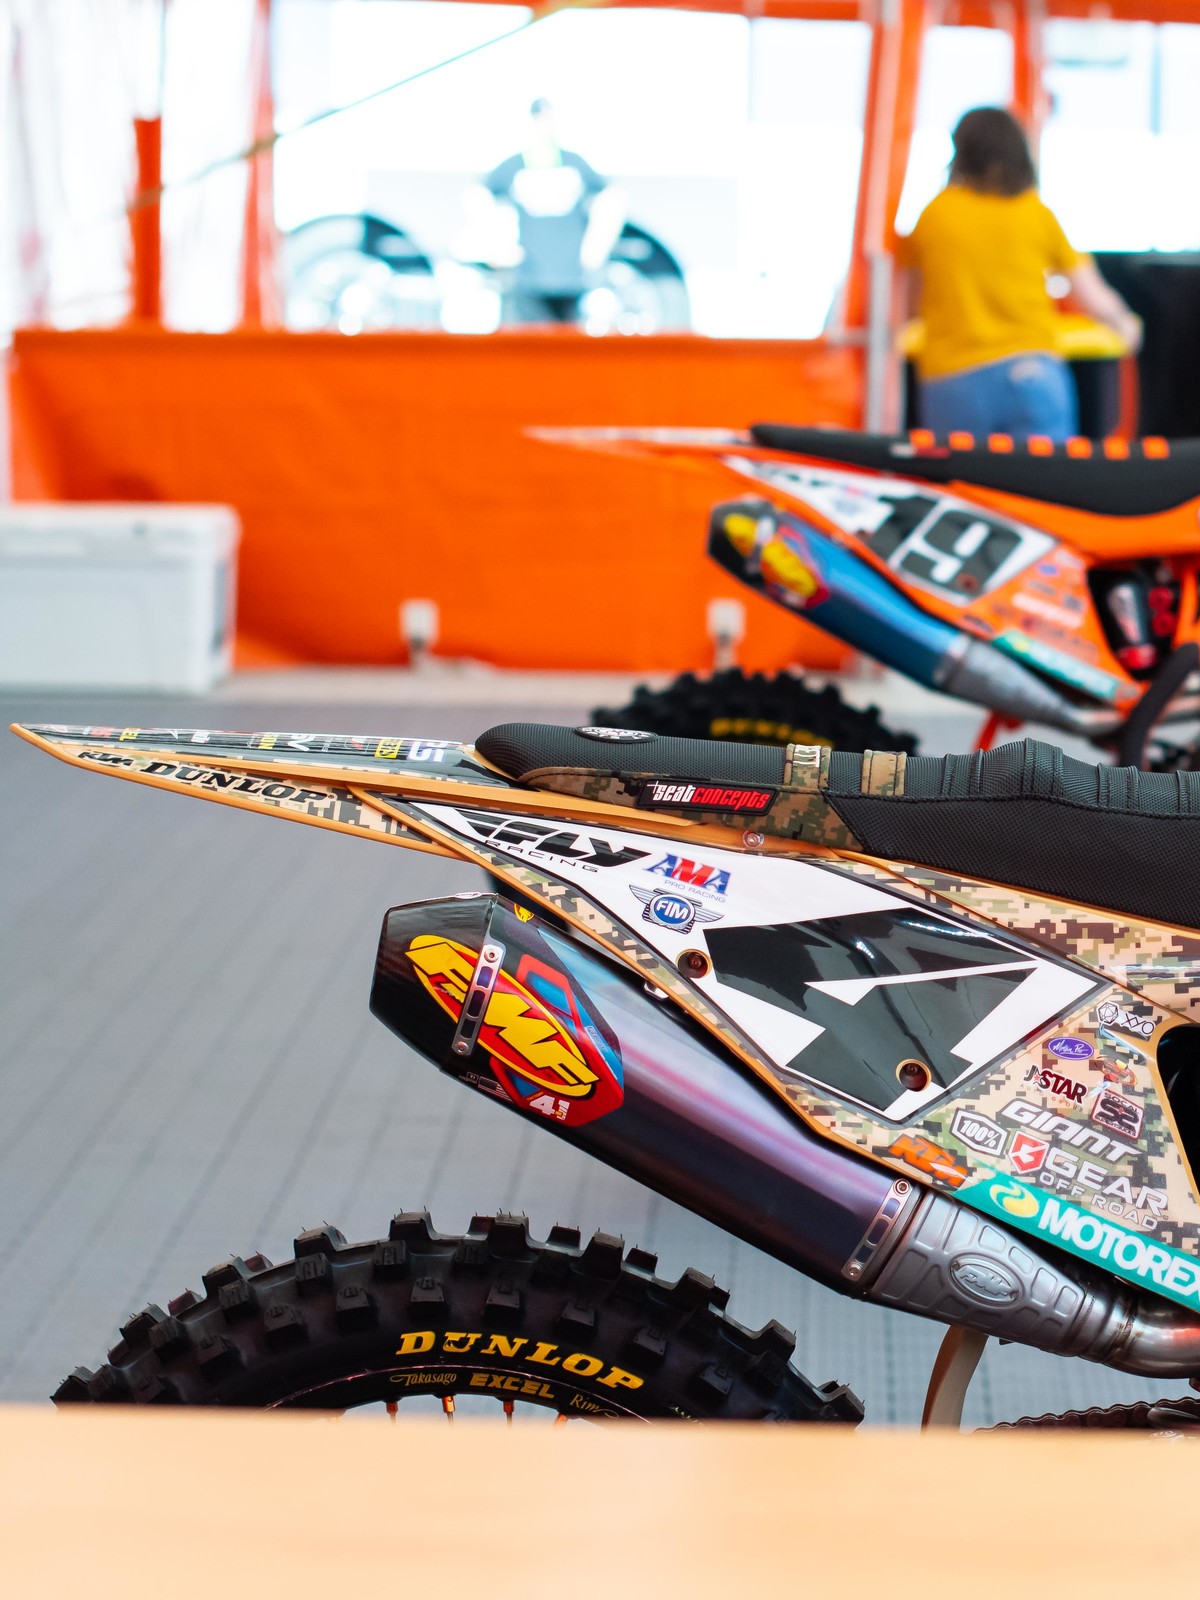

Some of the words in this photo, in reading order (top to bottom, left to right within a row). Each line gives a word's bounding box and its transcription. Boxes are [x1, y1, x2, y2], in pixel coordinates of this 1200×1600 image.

[862, 495, 1022, 600] 19
[78, 751, 134, 766] KTM
[140, 761, 328, 804] DUNLOP
[485, 840, 598, 873] RACING
[643, 852, 732, 896] AMA
[656, 900, 689, 920] FIM
[664, 879, 686, 891] PRO
[688, 886, 726, 903] RACING
[404, 941, 601, 1087] FMF
[960, 1119, 1000, 1148] 100%
[1039, 1170, 1086, 1197] OFF
[1092, 1194, 1159, 1230] ROAD
[1046, 1145, 1169, 1219] GEAR
[395, 1330, 645, 1390] DUNLOP
[389, 1371, 458, 1388] Takasago
[469, 1372, 555, 1399] EXCEL
[570, 1393, 609, 1416] Rim
